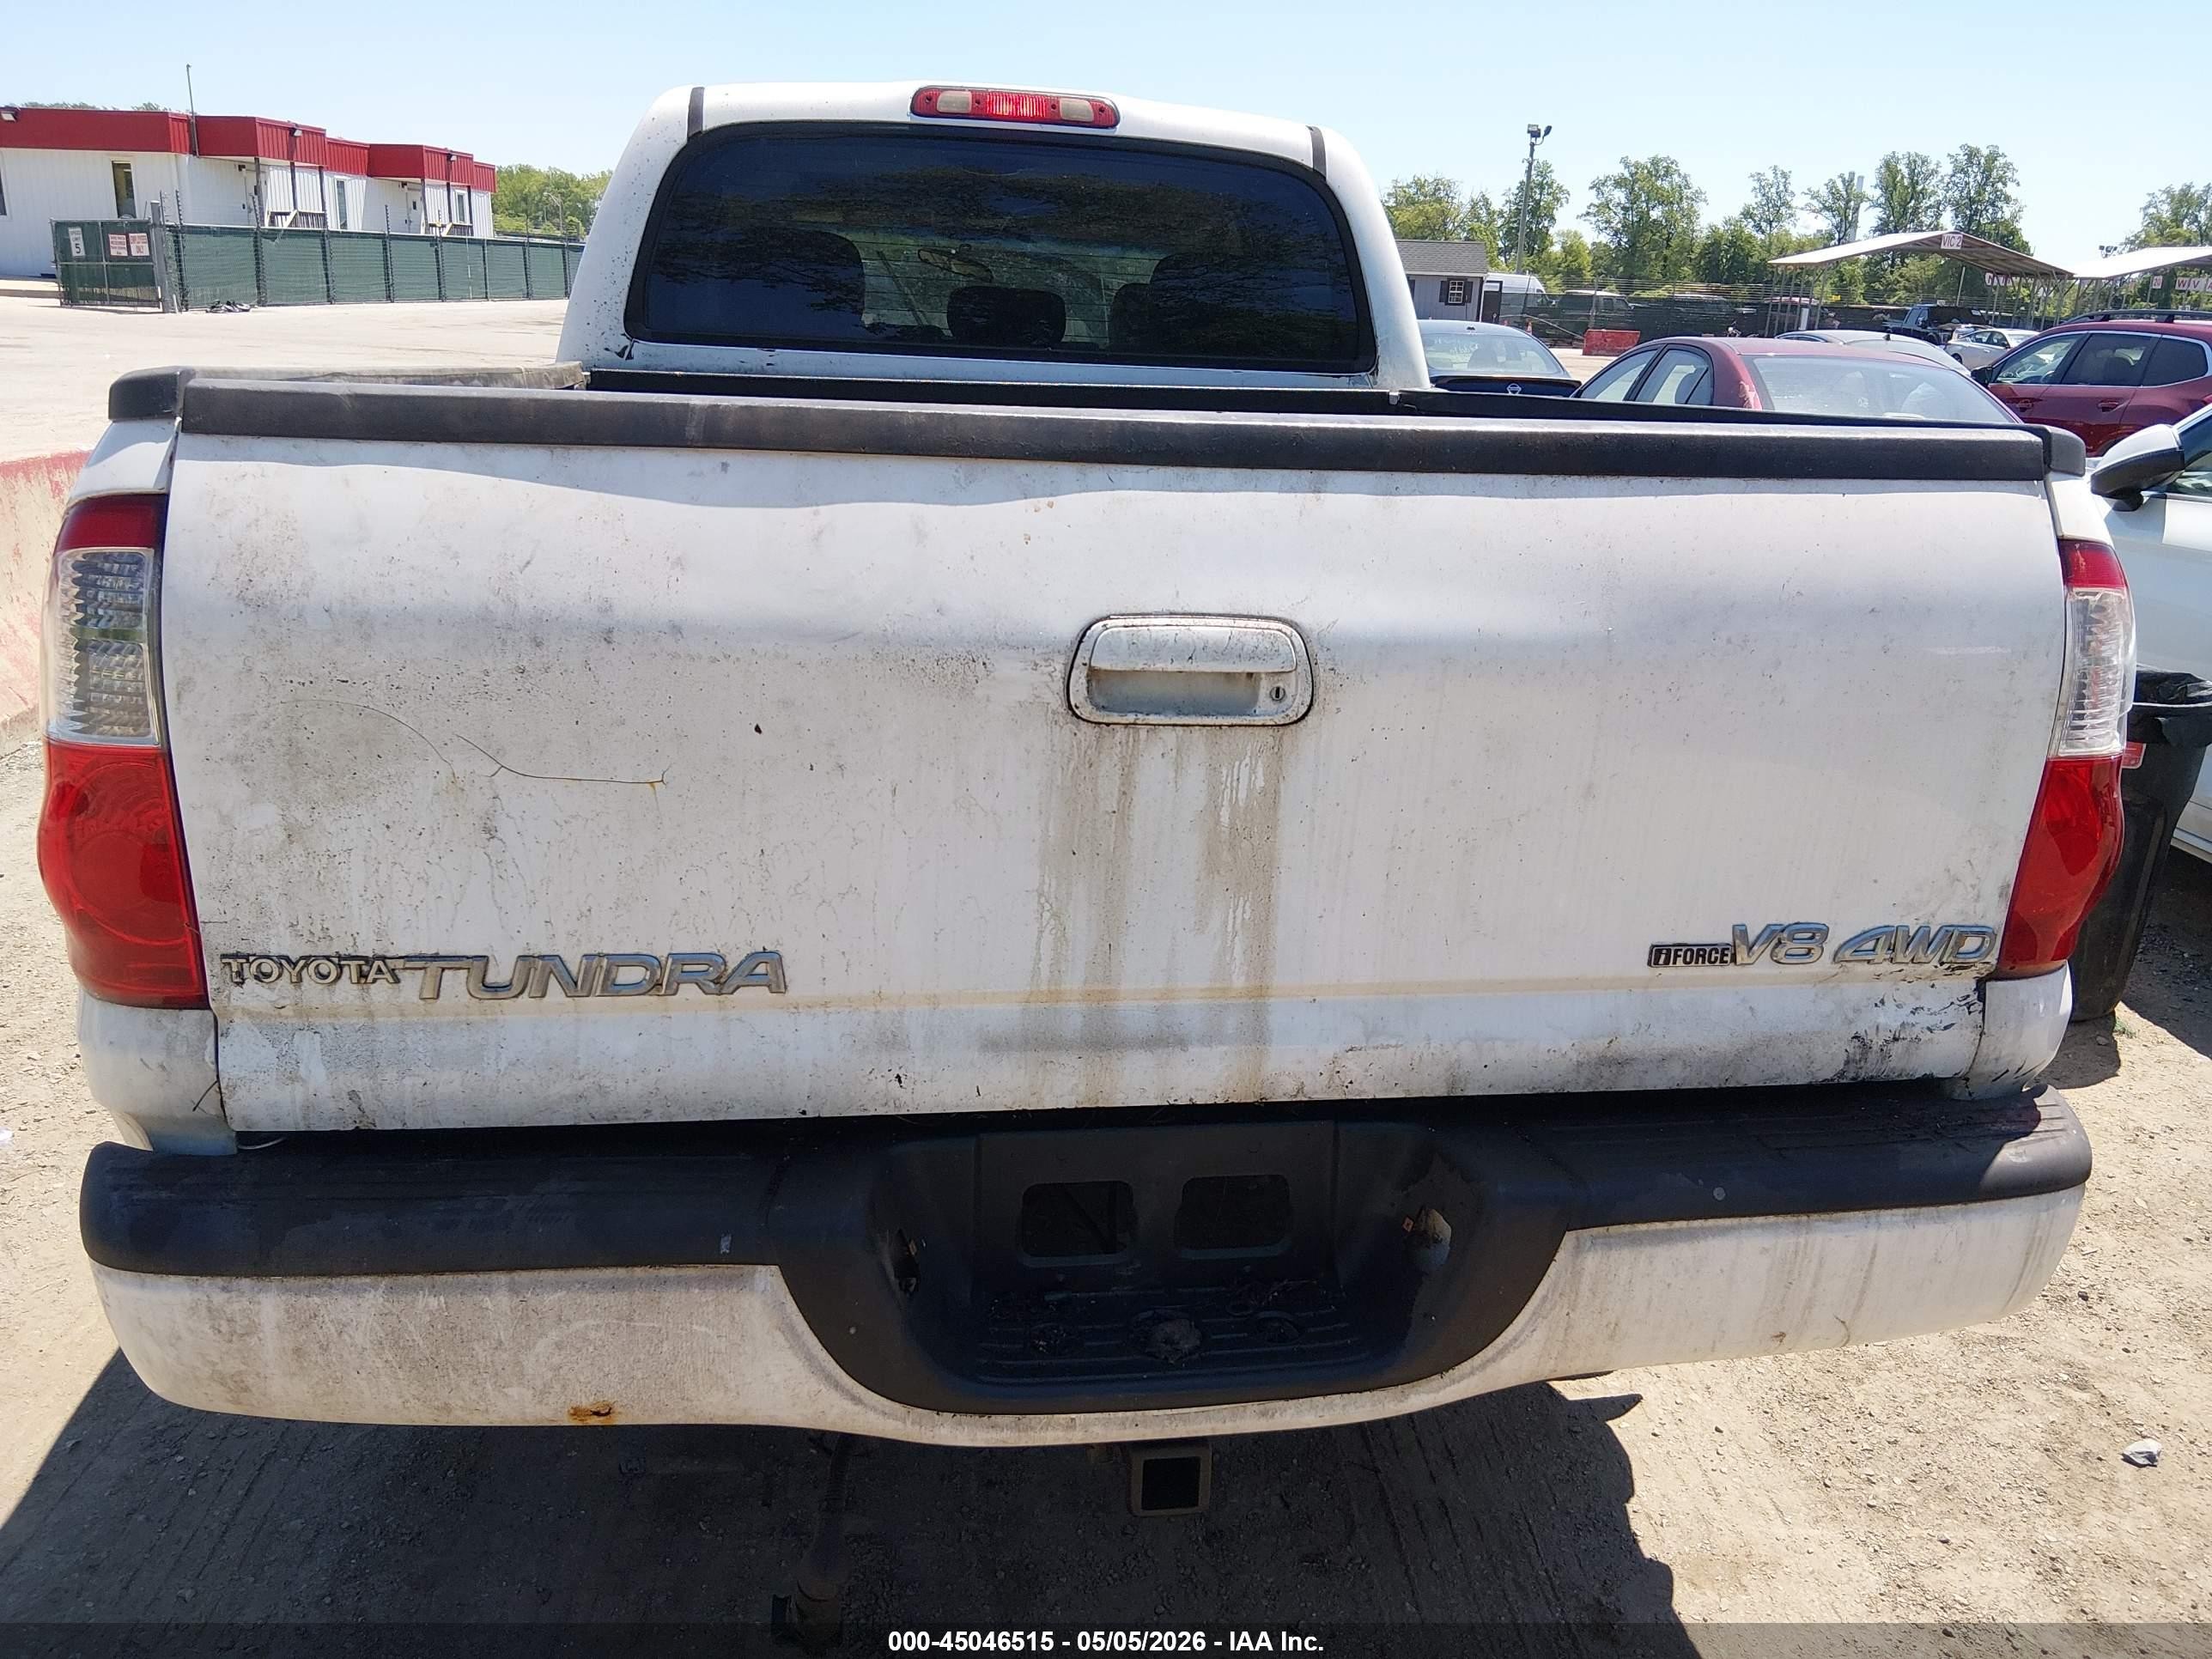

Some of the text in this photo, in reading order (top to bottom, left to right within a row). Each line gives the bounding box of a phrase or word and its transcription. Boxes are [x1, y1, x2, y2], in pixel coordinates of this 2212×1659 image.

[75, 243, 82, 254] 5
[1942, 235, 1962, 247] VIC 2
[1732, 921, 1829, 965] V8
[1833, 924, 1997, 963] 4WD
[220, 951, 786, 1000] TOYOTA TUNDRA
